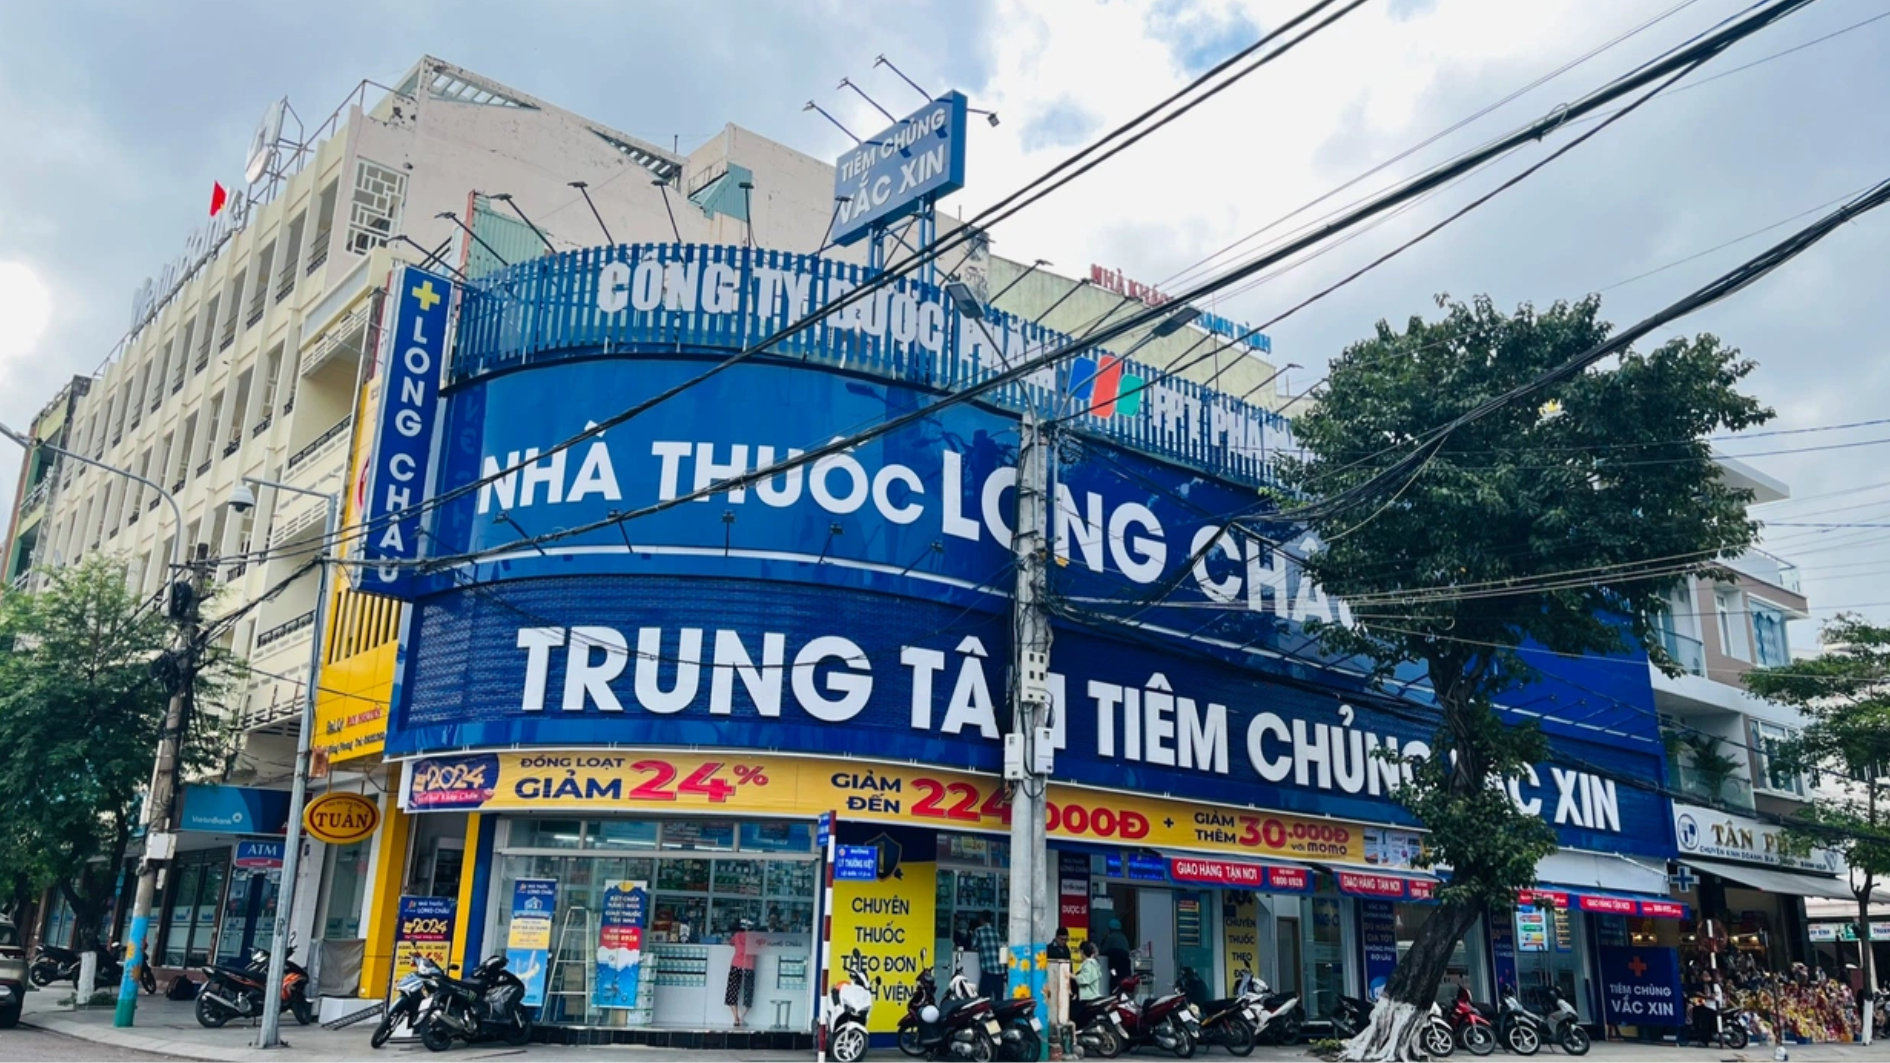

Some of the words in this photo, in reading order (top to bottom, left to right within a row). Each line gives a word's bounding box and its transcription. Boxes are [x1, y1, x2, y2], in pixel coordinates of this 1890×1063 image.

[842, 146, 876, 182] TIÊM
[836, 171, 891, 224] VẮC
[899, 144, 944, 194] XIN
[599, 249, 734, 314] CÔNG
[752, 267, 812, 323] TY
[395, 315, 431, 437] LONG
[478, 419, 621, 515] NHÀ
[651, 435, 926, 525] THUỐC
[517, 626, 874, 722] TRUNG
[1088, 672, 1229, 775] TIÊM
[576, 756, 626, 770] LOẠT
[427, 764, 487, 790] 2024
[514, 769, 623, 800] GIẢM
[628, 758, 769, 803] 24%
[830, 769, 902, 793] GIẢM
[846, 793, 901, 813] ĐẾN
[1549, 767, 1621, 832] XIN
[192, 815, 232, 825] VietinBank
[1194, 809, 1236, 828] GIẢM
[1195, 827, 1237, 844] THÊM
[1711, 819, 1754, 850] TÂN
[248, 844, 277, 856] ATM
[1307, 842, 1348, 855] momo
[1177, 861, 1198, 875] GIAO
[1200, 861, 1222, 877] HÀNG
[1225, 866, 1241, 881] TẬN
[1243, 867, 1258, 880] NƠI
[1359, 874, 1376, 889] HÀNG
[852, 895, 910, 915] CHUYÊN
[413, 918, 448, 934] 2024
[855, 920, 905, 944] THUỐC
[1226, 916, 1256, 928] CHUYÊN
[1228, 932, 1255, 945] THUỐC
[883, 953, 917, 972] ĐƠN
[1232, 952, 1253, 961] THEO
[883, 983, 914, 1006] VIỆN
[1610, 983, 1632, 996] TIÊM
[1634, 981, 1672, 997] CHỦNG
[1611, 996, 1644, 1014] VẮC
[1648, 1001, 1675, 1016] XIN
